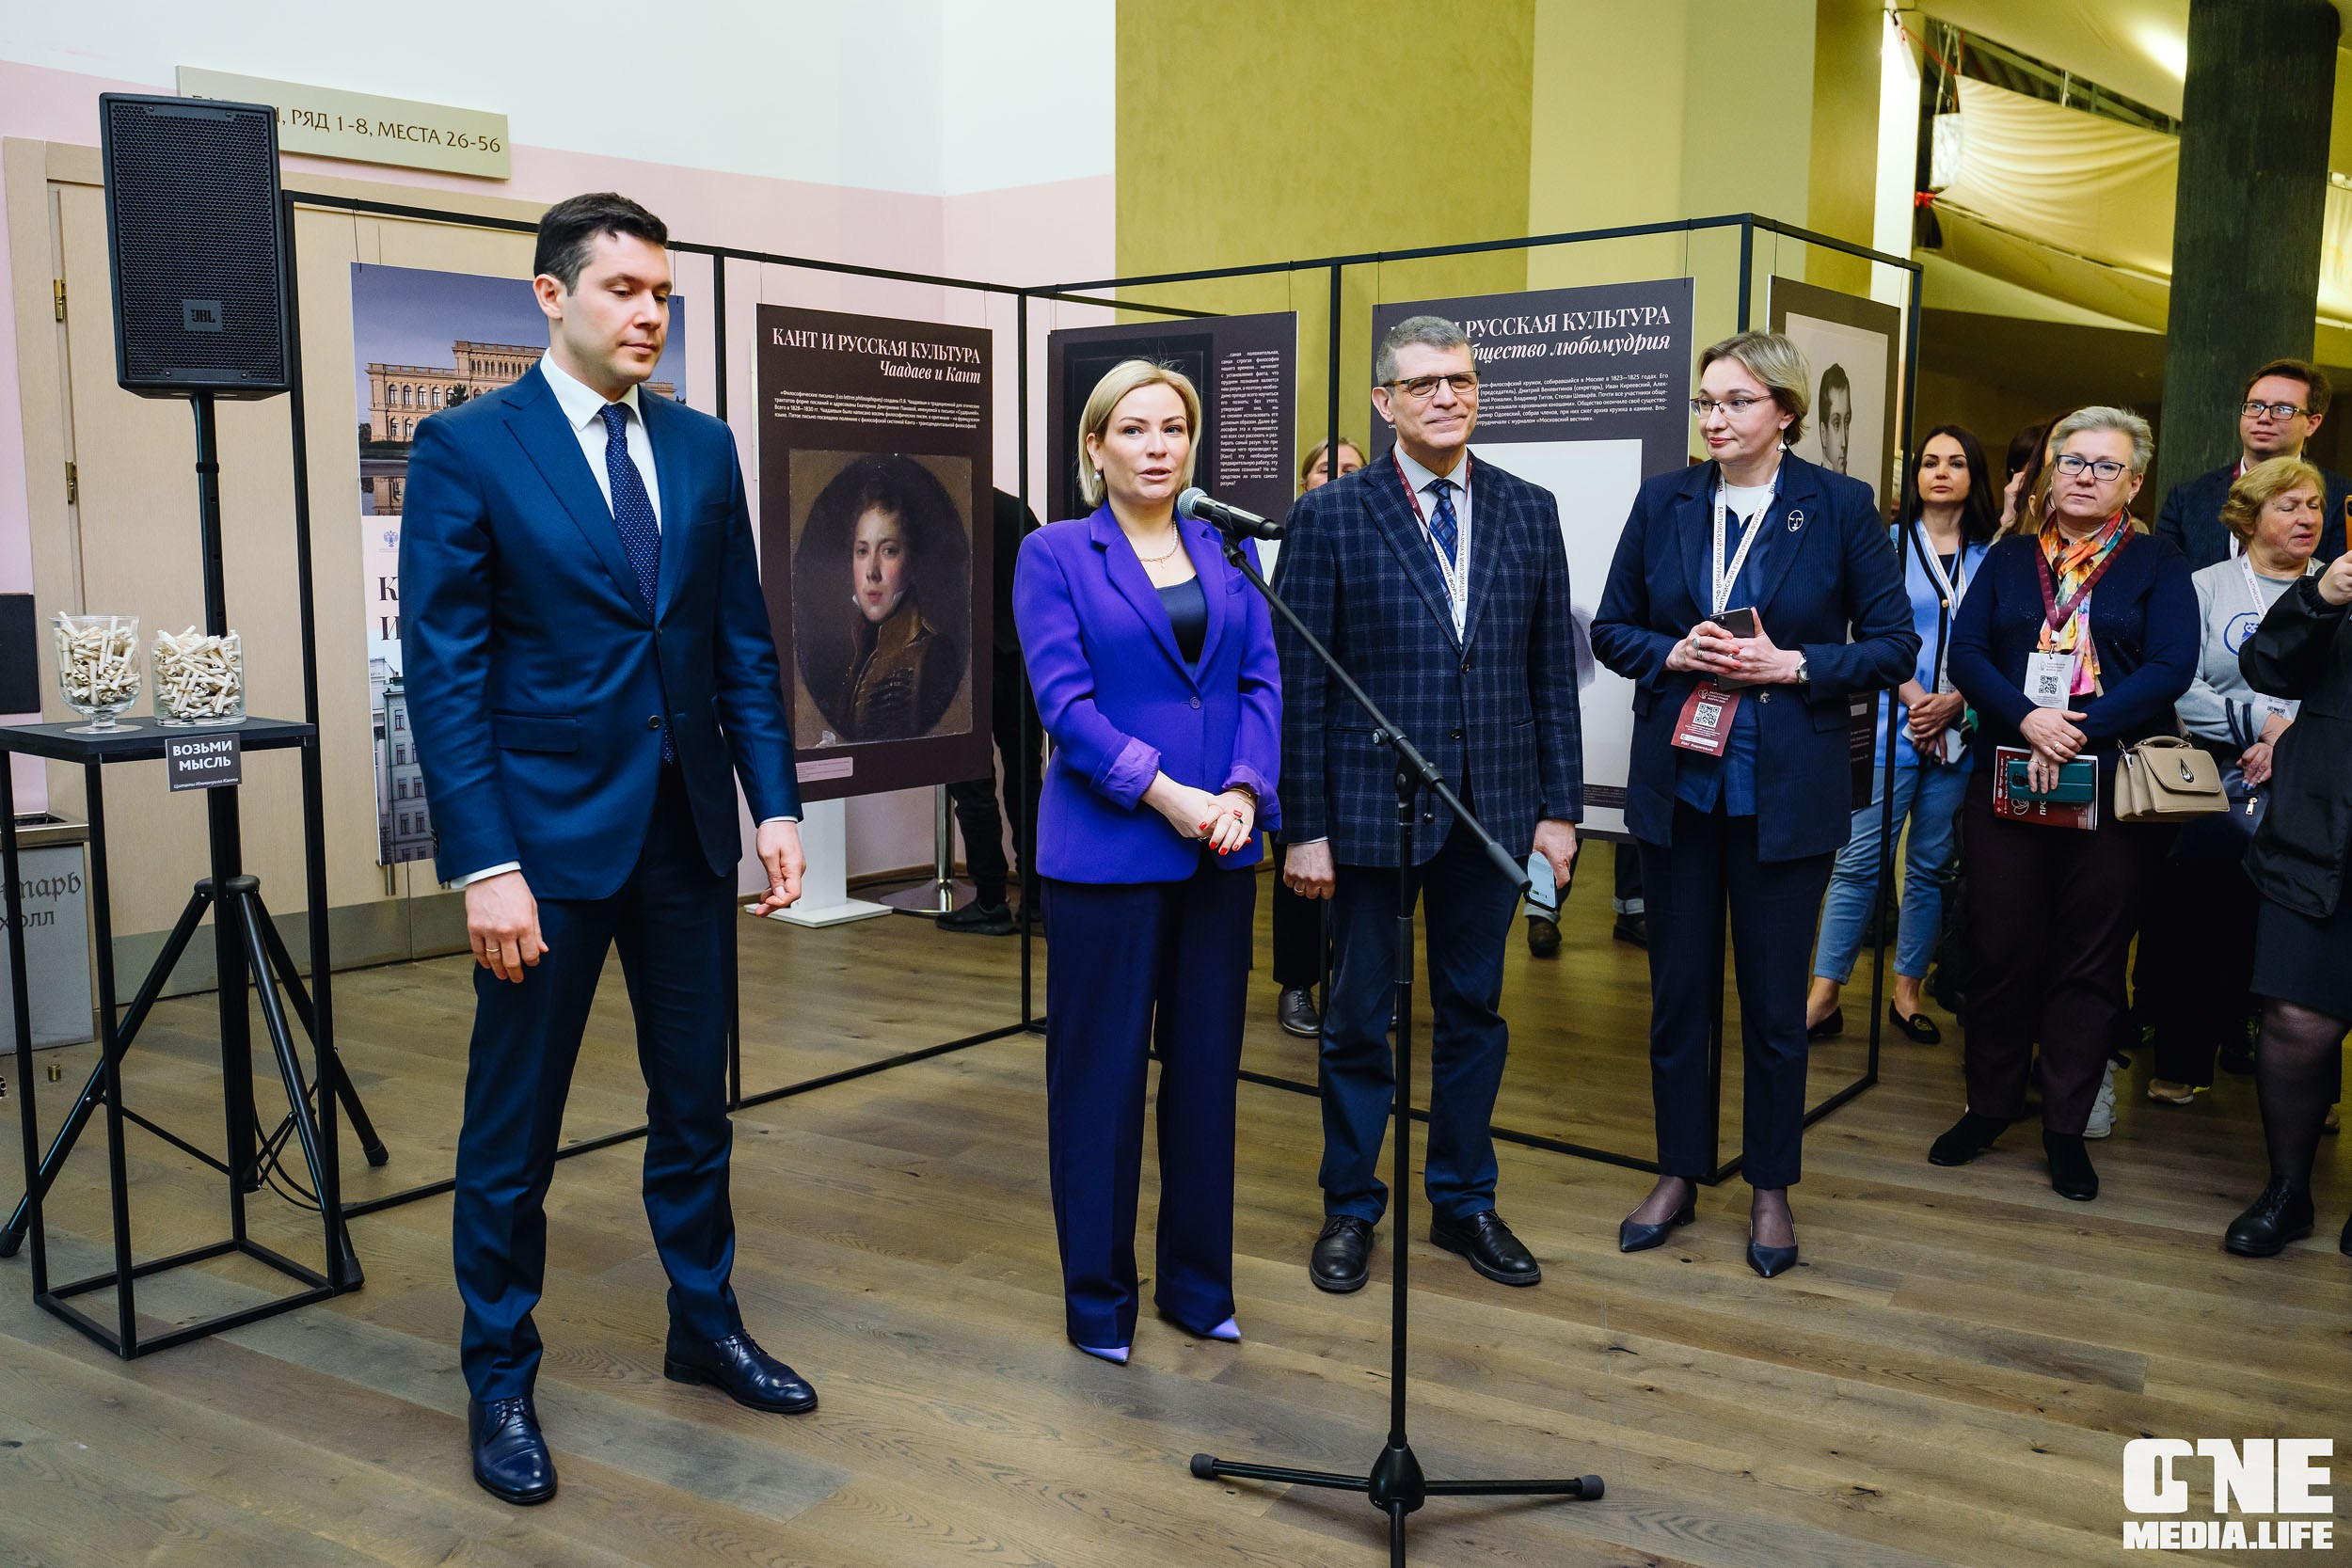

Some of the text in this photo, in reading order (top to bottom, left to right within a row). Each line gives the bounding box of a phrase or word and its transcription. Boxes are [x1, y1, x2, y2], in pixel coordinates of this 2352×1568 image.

[292, 109, 330, 133] РЯД
[378, 121, 441, 145] МЕСТА
[446, 132, 501, 153] 26-56
[191, 309, 216, 323] JBL
[1466, 314, 1557, 338] РУССКАЯ
[1562, 306, 1671, 331] КУЛЬТУРА
[772, 328, 980, 364] КАНТ И РУССКАЯ КУЛЬТУРА
[1471, 332, 1670, 363] бщество любомудрия
[880, 360, 981, 384] Чаадаев и Кант
[1750, 508, 1764, 531] ФОРУМ
[378, 576, 399, 601] К
[1448, 578, 1458, 603] ФОРУ
[173, 740, 232, 757] ВОЗЬМИ
[179, 756, 231, 771] МЫСЛЬ
[0, 871, 81, 902] тарь
